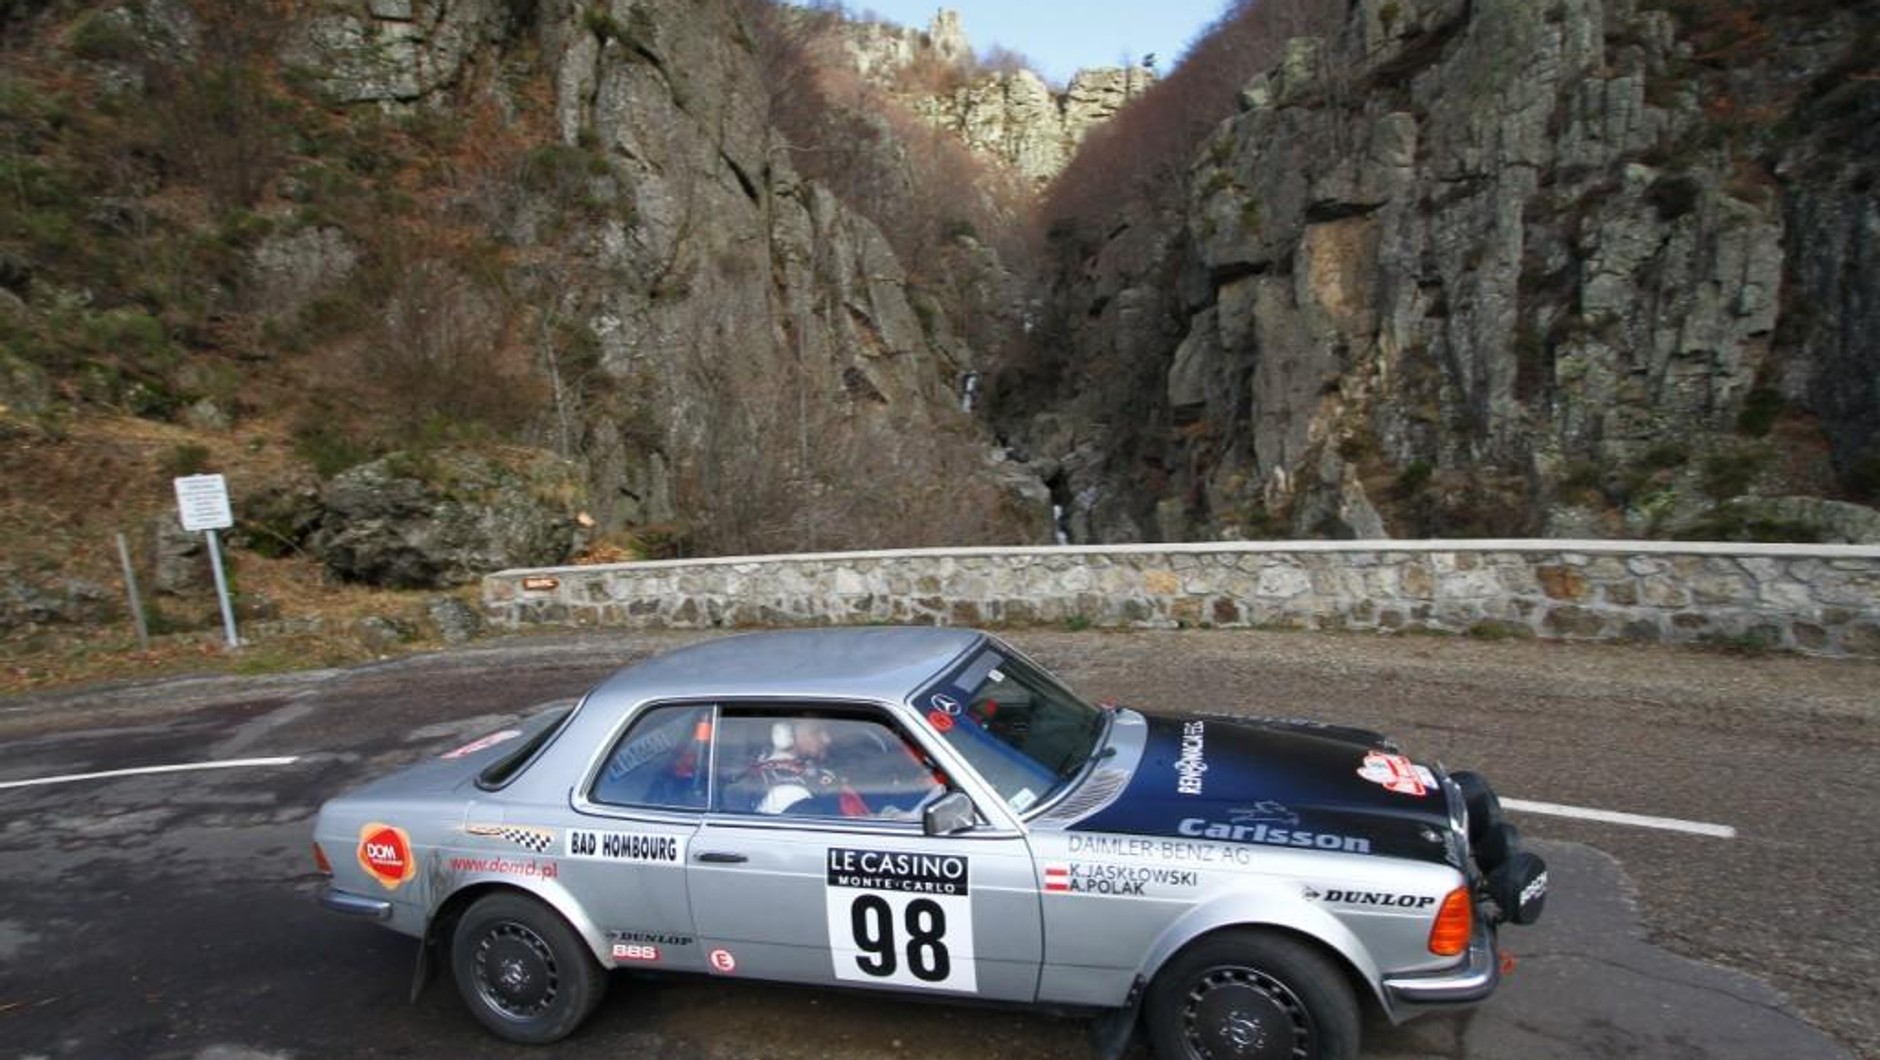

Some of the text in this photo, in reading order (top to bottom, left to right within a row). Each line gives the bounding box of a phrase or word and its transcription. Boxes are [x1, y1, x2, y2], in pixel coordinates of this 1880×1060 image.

[571, 832, 677, 861] BAD HOMBOURG
[1178, 818, 1371, 853] Carlsson
[367, 843, 397, 860] DOM
[1069, 835, 1250, 865] DAIMLER-BENZ AG
[831, 850, 963, 879] LE CASINO
[1070, 879, 1145, 895] A.POLAK
[1323, 889, 1436, 908] DUNLOP
[619, 931, 693, 946] DUNLOP
[851, 894, 950, 982] 98
[612, 944, 657, 959] BBS
